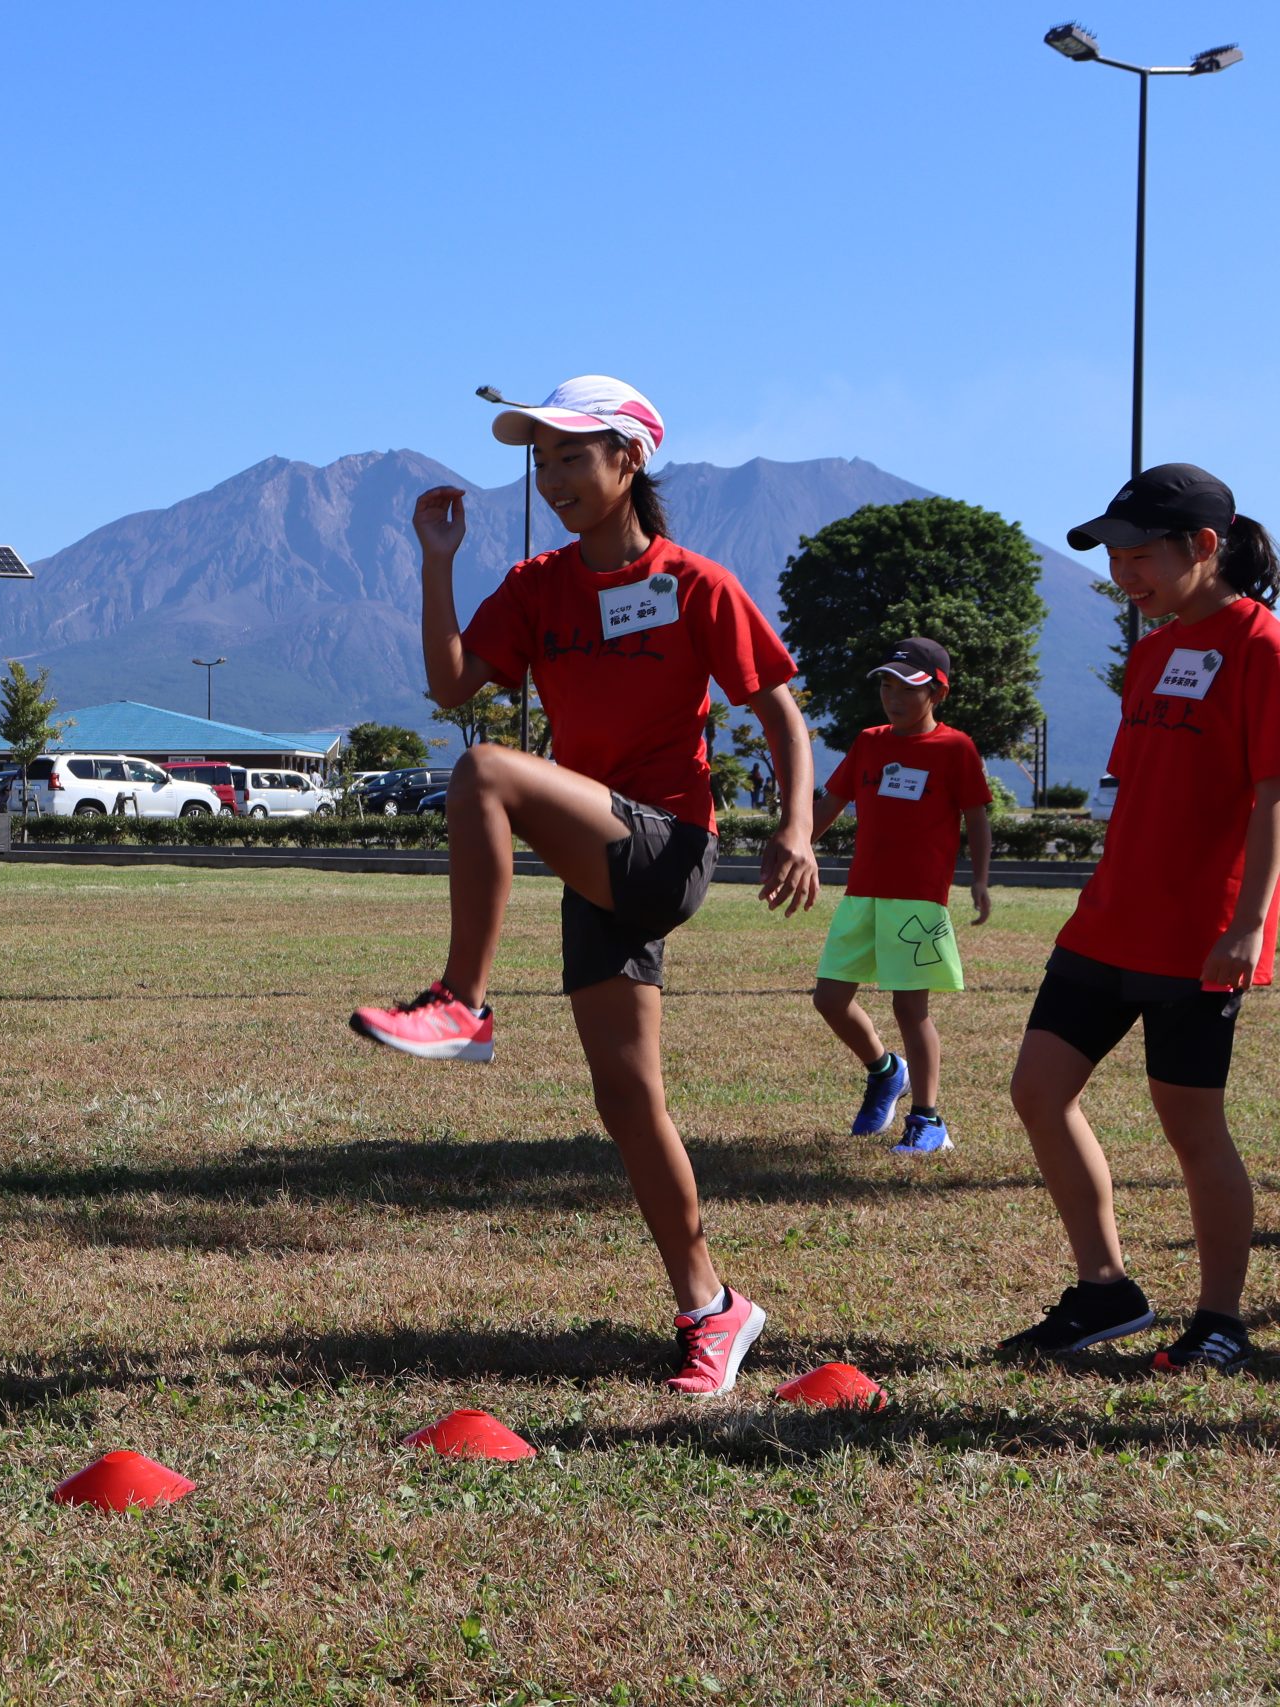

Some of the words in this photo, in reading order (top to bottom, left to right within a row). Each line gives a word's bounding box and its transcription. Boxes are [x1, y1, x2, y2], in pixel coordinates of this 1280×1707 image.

[609, 604, 632, 615] ふくなが
[640, 599, 652, 607] あこ
[609, 613, 630, 626] 福永
